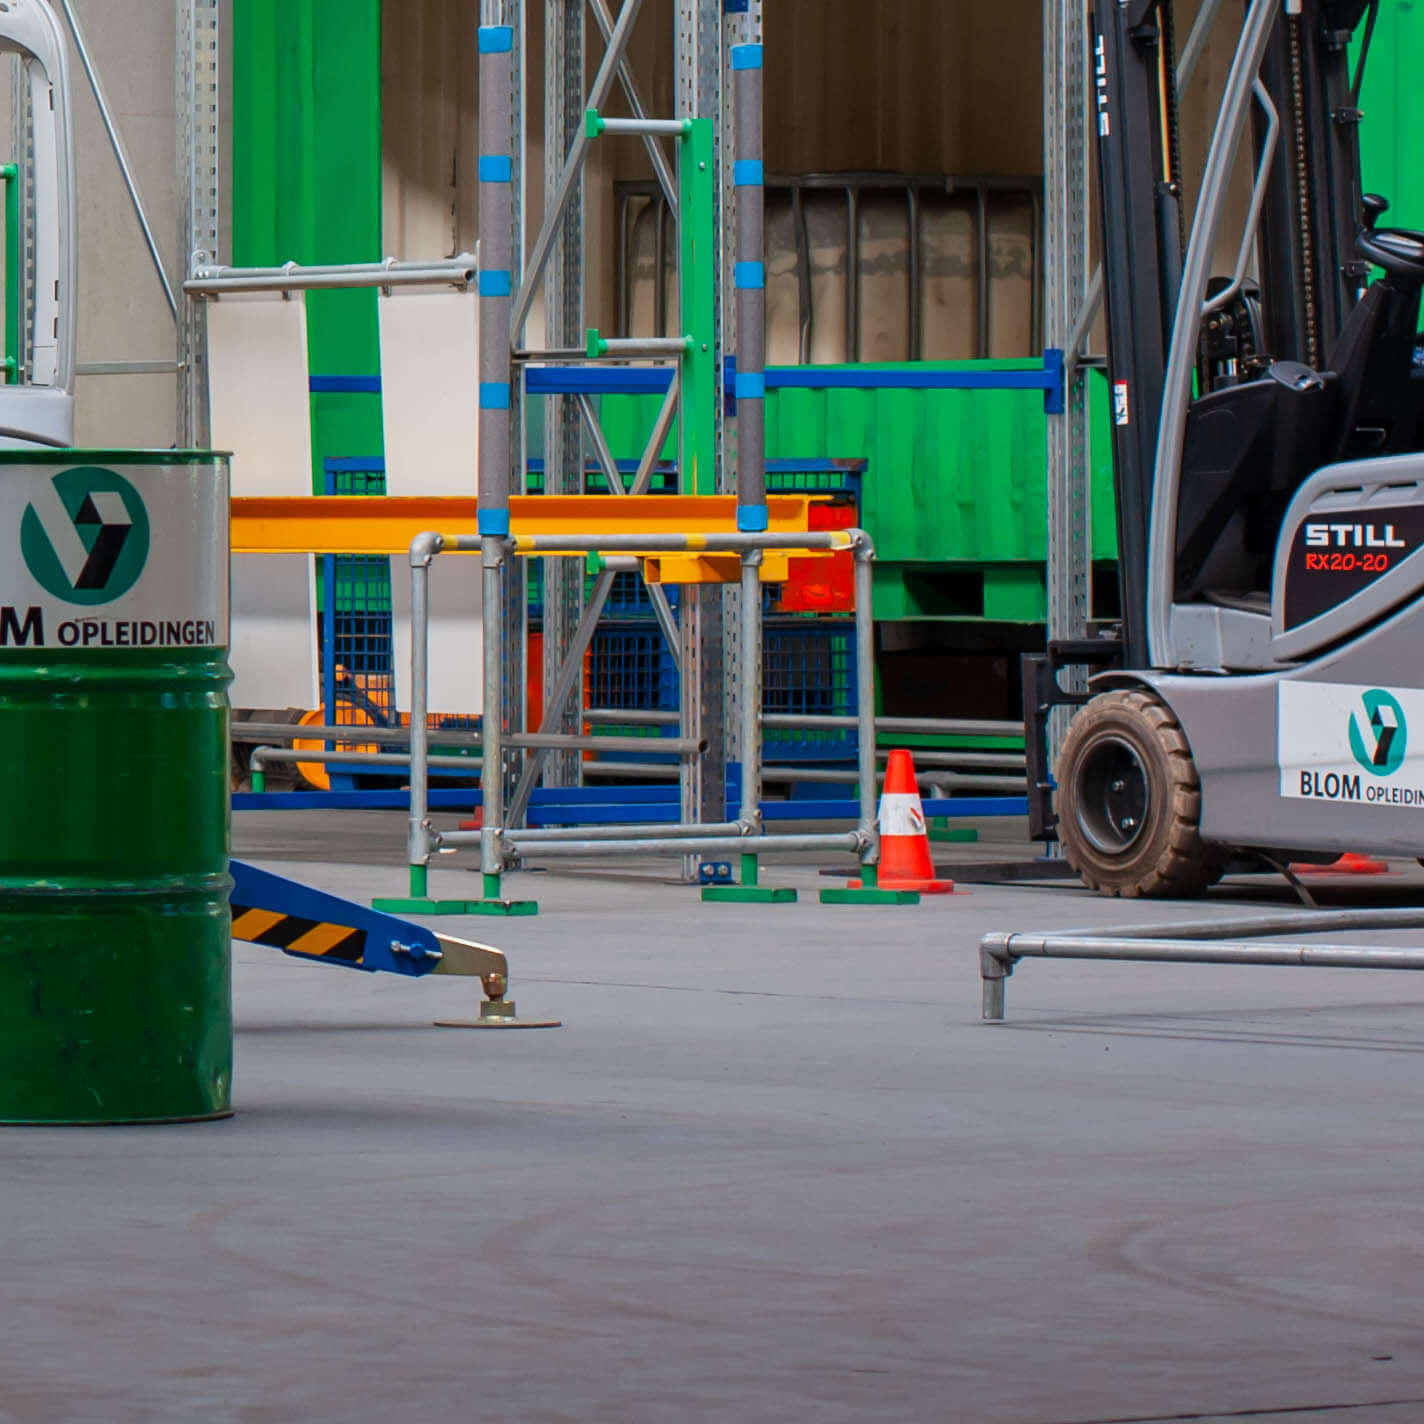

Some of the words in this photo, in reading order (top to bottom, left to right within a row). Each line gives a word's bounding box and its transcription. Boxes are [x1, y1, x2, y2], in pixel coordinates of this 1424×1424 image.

[1305, 523, 1406, 547] STILL
[1305, 552, 1389, 571] RX20-20
[57, 619, 216, 646] OPLEIDINGEN
[1300, 770, 1361, 800] BLOM
